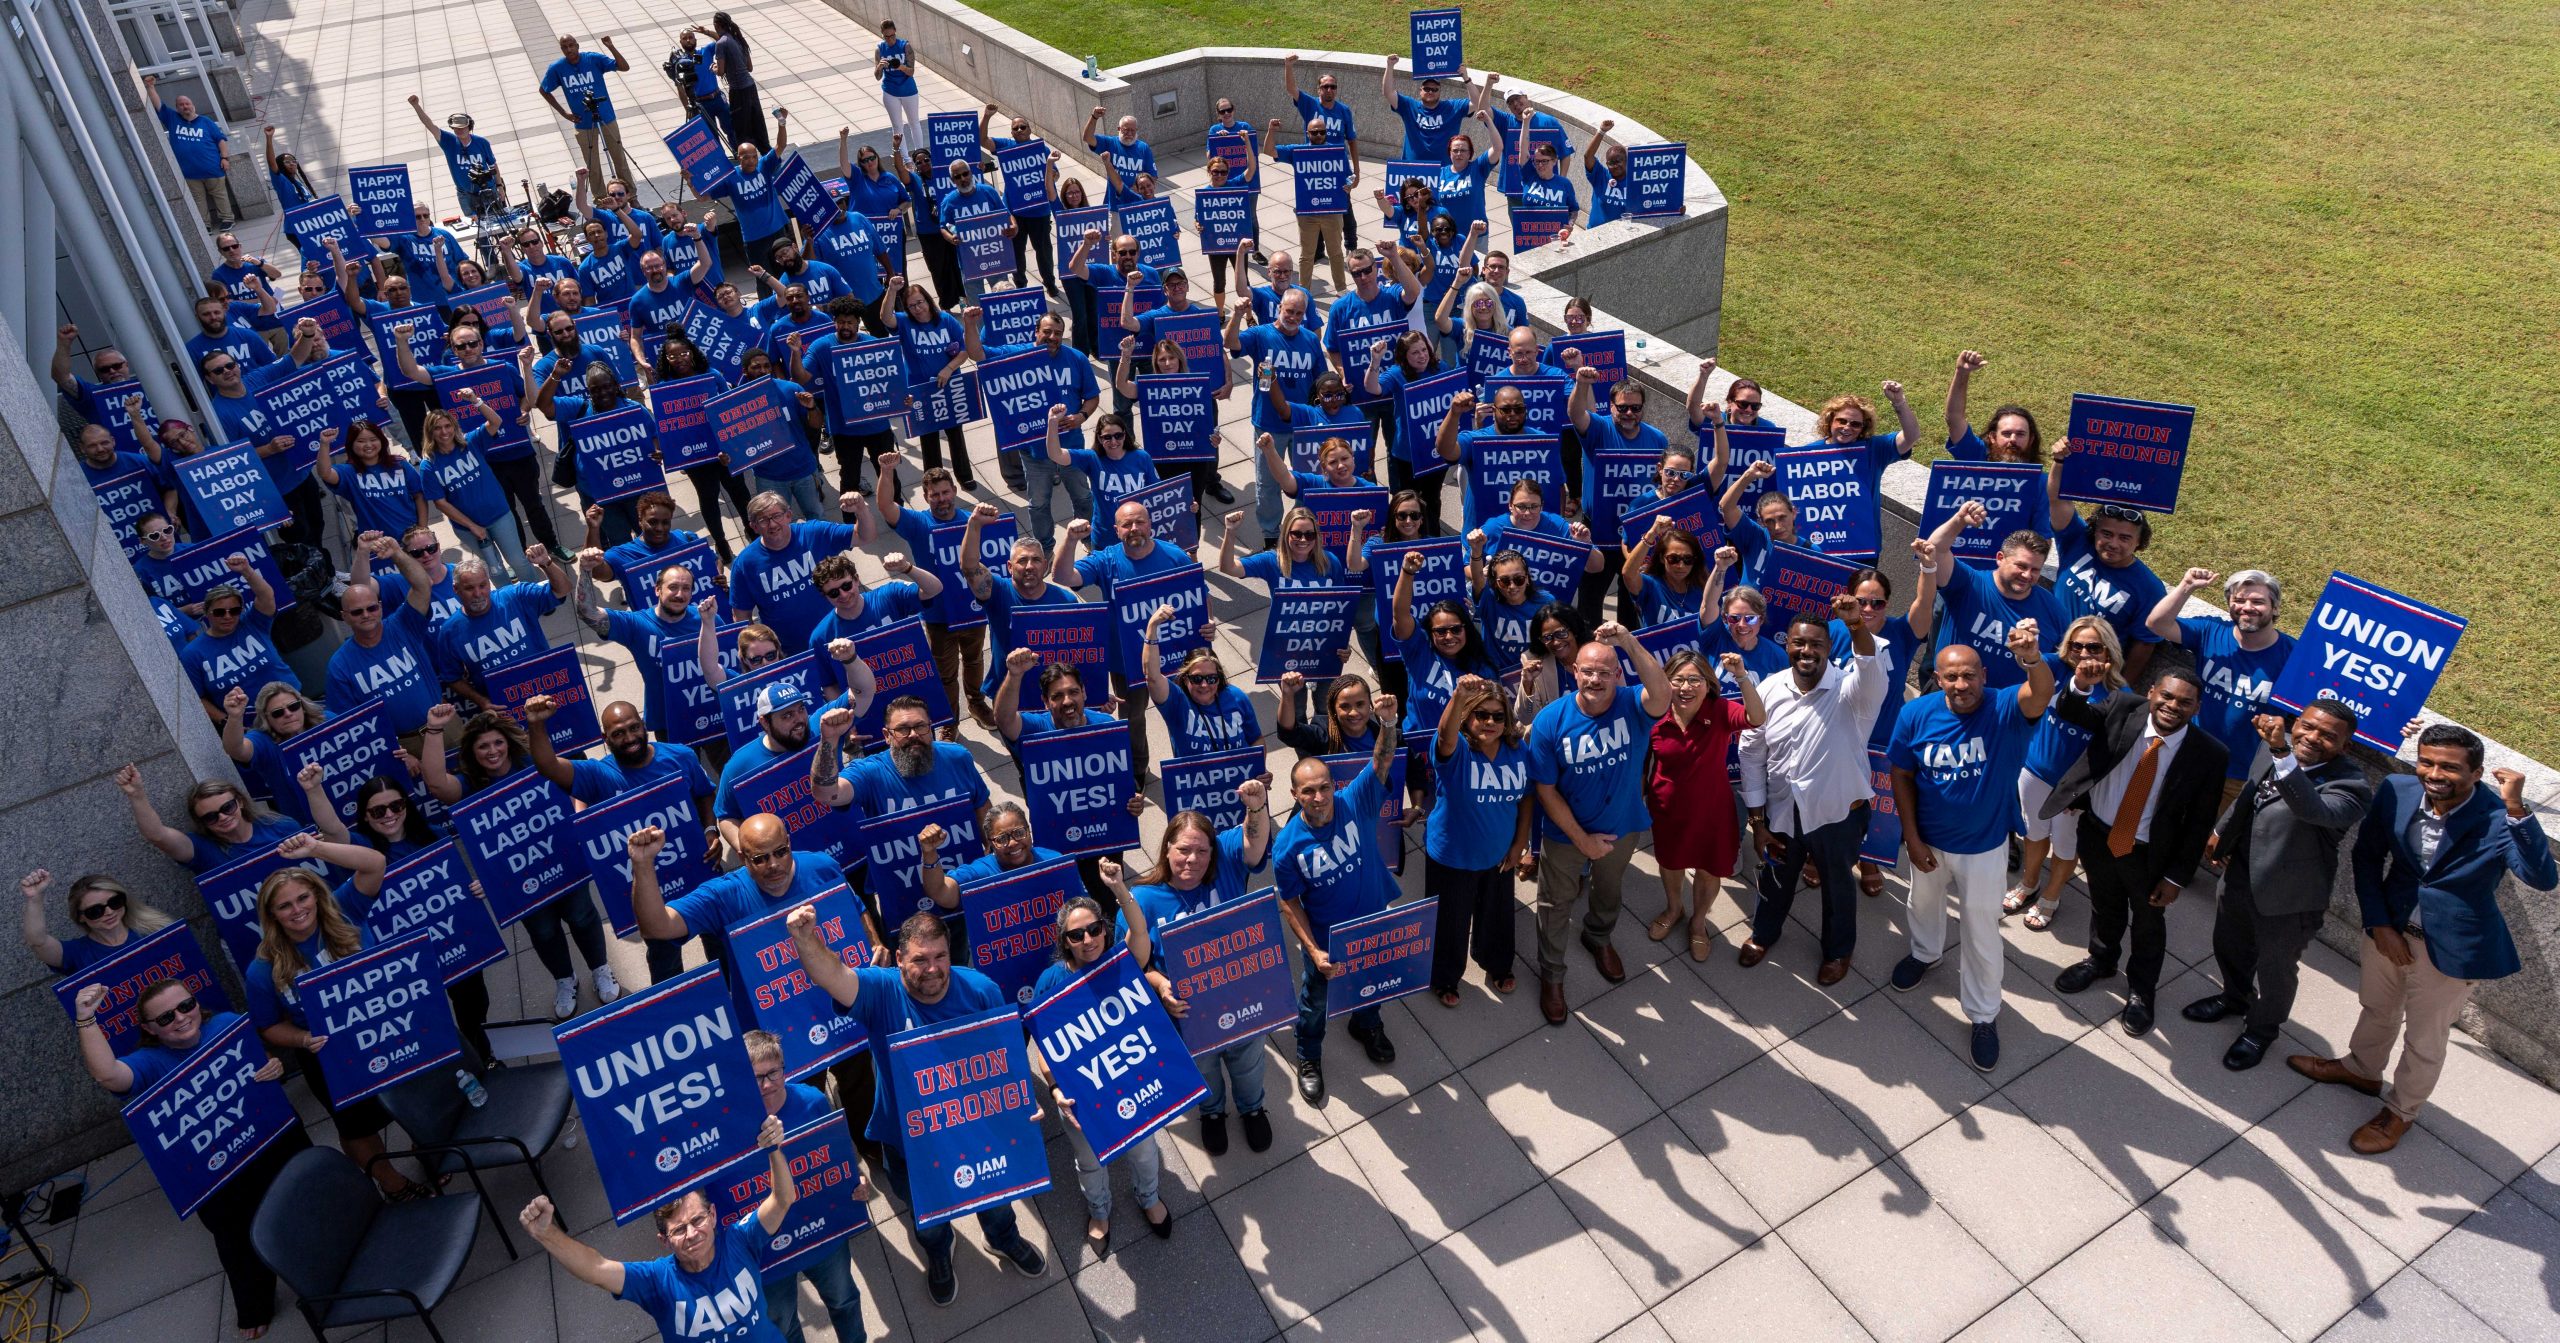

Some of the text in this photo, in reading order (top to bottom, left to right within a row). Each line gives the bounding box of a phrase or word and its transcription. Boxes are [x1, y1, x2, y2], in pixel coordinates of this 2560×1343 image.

[1417, 19, 1455, 30] HAPPY
[1417, 32, 1456, 43] LABOR
[1426, 45, 1448, 55] DAY
[563, 71, 595, 89] IAM
[934, 122, 973, 133] HAPPY
[1416, 114, 1443, 126] IAM
[175, 125, 204, 138] IAM
[935, 134, 975, 146] LABOR
[457, 153, 483, 164] IAM
[945, 146, 968, 158] DAY
[1634, 155, 1679, 166] HAPPY
[1002, 154, 1046, 173] UNION
[1112, 154, 1143, 172] IAM
[1296, 160, 1344, 173] UNION
[357, 173, 403, 190] HAPPY
[737, 172, 766, 193] IAM
[1013, 171, 1044, 187] YES!
[1305, 177, 1337, 189] YES!
[1440, 175, 1471, 193] IAM
[1633, 168, 1678, 180] LABOR
[360, 187, 406, 201] LABOR
[783, 166, 813, 204] UNION
[1526, 180, 1563, 202] IAM
[1643, 183, 1668, 195] DAY
[372, 201, 398, 215] DAY
[796, 186, 820, 214] YES!
[1203, 197, 1243, 207] HAPPY
[295, 209, 348, 236] UNION
[1126, 208, 1166, 224] HAPPY
[1204, 209, 1245, 220] LABOR
[1128, 221, 1169, 237] LABOR
[1214, 221, 1238, 232] DAY
[831, 228, 870, 252] IAM
[970, 239, 1003, 256] YES!
[1140, 234, 1163, 248] DAY
[590, 256, 624, 282] IAM
[650, 301, 684, 323] IAM
[990, 299, 1039, 316] HAPPY
[714, 333, 734, 360] DAY
[911, 329, 949, 345] IAM
[842, 350, 894, 369] HAPPY
[844, 365, 898, 383] LABOR
[986, 366, 1051, 395] UNION
[268, 377, 323, 411] HAPPY
[859, 382, 888, 396] DAY
[1147, 387, 1202, 399] HAPPY
[663, 394, 709, 414] UNION
[720, 395, 769, 423] UNION
[873, 400, 890, 409] IAM
[931, 389, 950, 422] YES!
[950, 377, 969, 423] UNION
[1002, 391, 1048, 415] YES!
[1149, 403, 1205, 416] LABOR
[277, 394, 334, 427] LABOR
[297, 414, 329, 437] DAY
[719, 408, 780, 441] STRONG!
[1029, 419, 1045, 428] IAM
[1162, 420, 1195, 433] DAY
[2086, 418, 2171, 443] UNION
[579, 423, 647, 455] UNION
[692, 442, 707, 451] IAM
[755, 441, 772, 452] IAM
[1177, 441, 1194, 449] IAM
[595, 446, 643, 470] YES!
[1483, 450, 1550, 465] HAPPY
[2070, 438, 2180, 466] STRONG!
[190, 453, 250, 481] HAPPY
[436, 451, 480, 485] IAM
[1787, 460, 1857, 478] HAPPY
[198, 470, 261, 499] LABOR
[358, 470, 405, 489] IAM
[449, 471, 480, 491] UNION
[625, 473, 641, 482] IAM
[1099, 472, 1144, 491] IAM
[1484, 470, 1550, 485] LABOR
[1943, 476, 2027, 493] HAPPY
[2115, 481, 2142, 491] IAM
[222, 491, 257, 511] DAY
[1788, 481, 1860, 501] LABOR
[245, 508, 264, 518] IAM
[1806, 505, 1846, 522] DAY
[1825, 531, 1846, 539] IAM
[1967, 537, 1991, 547] IAM
[760, 551, 816, 593] IAM
[1780, 568, 1847, 595] UNION
[2070, 553, 2131, 615] IAM
[1281, 601, 1349, 615] HAPPY
[1027, 627, 1094, 645] UNION
[1276, 620, 1344, 634] LABOR
[2318, 602, 2444, 670] UNION
[465, 617, 527, 663] IAM
[1287, 638, 1326, 652] DAY
[203, 635, 266, 681] IAM
[482, 642, 527, 669] UNION
[1299, 659, 1319, 668] IAM
[216, 657, 269, 689] UNION
[355, 647, 417, 694] IAM
[2323, 642, 2407, 696] YES!
[505, 668, 569, 701] UNION
[778, 683, 797, 696] IAM
[2201, 660, 2272, 703] IAM
[2205, 687, 2257, 712] UNION
[300, 717, 378, 766] HAPPY
[551, 728, 573, 742] IAM
[1562, 717, 1630, 764] IAM
[1191, 742, 1242, 751] UNION
[1924, 736, 1987, 768] IAM
[1030, 749, 1128, 784] UNION
[1575, 752, 1628, 775] UNION
[332, 764, 377, 799] DAY
[1176, 764, 1253, 789] HAPPY
[1471, 762, 1526, 790] IAM
[1933, 769, 1982, 781] UNION
[470, 782, 552, 835] HAPPY
[1048, 784, 1116, 814] YES!
[1477, 795, 1523, 803] UNION
[480, 805, 565, 859] LABOR
[1084, 823, 1107, 834] IAM
[508, 835, 555, 874] DAY
[1297, 820, 1360, 879] IAM
[540, 864, 564, 885] IAM
[984, 890, 1065, 931] UNION
[1184, 923, 1265, 967] UNION
[1346, 923, 1421, 956] UNION
[440, 944, 466, 964] IAM
[319, 953, 420, 1008] HAPPY
[1178, 945, 1282, 999] STRONG!
[1378, 977, 1401, 988] IAM
[326, 980, 430, 1034] LABOR
[1235, 1002, 1262, 1019] IAM
[1042, 978, 1151, 1063] UNION
[356, 1012, 414, 1050] DAY
[390, 1042, 420, 1062] IAM
[576, 1006, 733, 1098] UNION
[1078, 1027, 1157, 1089] YES!
[915, 1049, 1007, 1096] UNION
[148, 1039, 244, 1127] HAPPY
[1133, 1078, 1162, 1102] IAM
[158, 1063, 256, 1150] LABOR
[615, 1064, 726, 1135] YES!
[1142, 1091, 1164, 1106] UNION
[906, 1080, 1030, 1138] STRONG!
[192, 1097, 245, 1153] DAY
[227, 1125, 256, 1152] IAM
[682, 1128, 720, 1153] IAM
[690, 1142, 720, 1159] UNION
[977, 1156, 1007, 1175] IAM
[982, 1169, 1006, 1180] UNION
[793, 1217, 825, 1239] IAM
[675, 1267, 758, 1338] IAM
